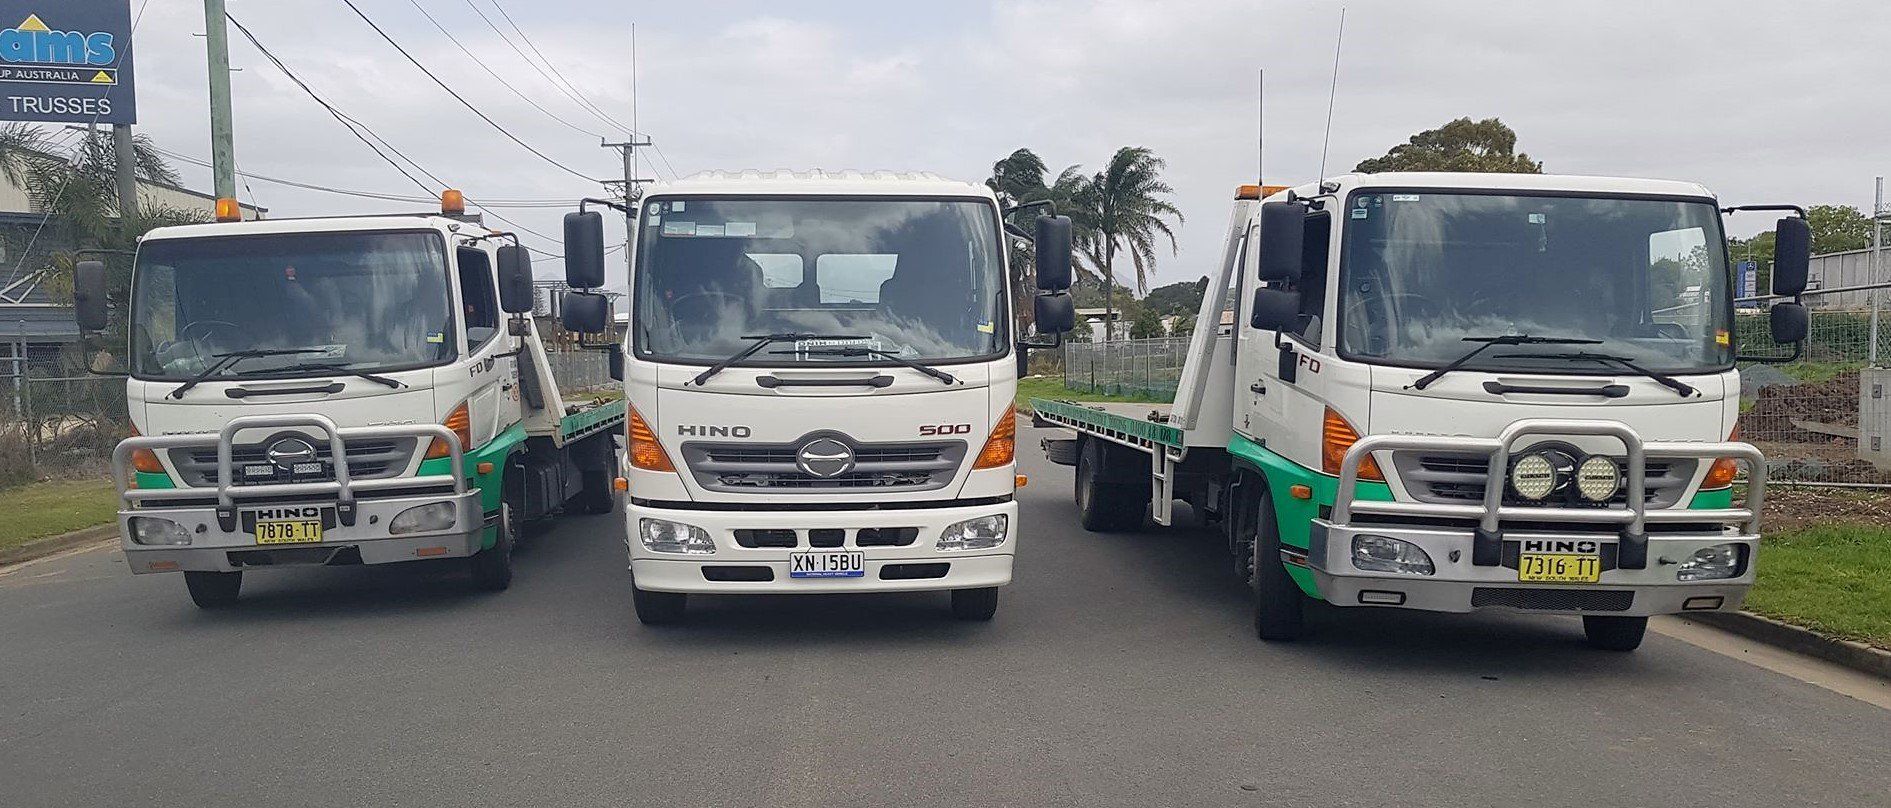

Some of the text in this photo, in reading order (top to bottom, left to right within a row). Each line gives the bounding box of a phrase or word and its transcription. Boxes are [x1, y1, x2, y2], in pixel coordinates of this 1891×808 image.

[16, 70, 80, 80] AUSTRALIA
[8, 96, 111, 115] TRUSSES
[469, 361, 483, 378] FD
[1300, 354, 1321, 374] FD
[677, 425, 751, 438] HINO
[919, 424, 971, 436] 500
[258, 507, 319, 519] HINO
[1525, 541, 1597, 553] HINO
